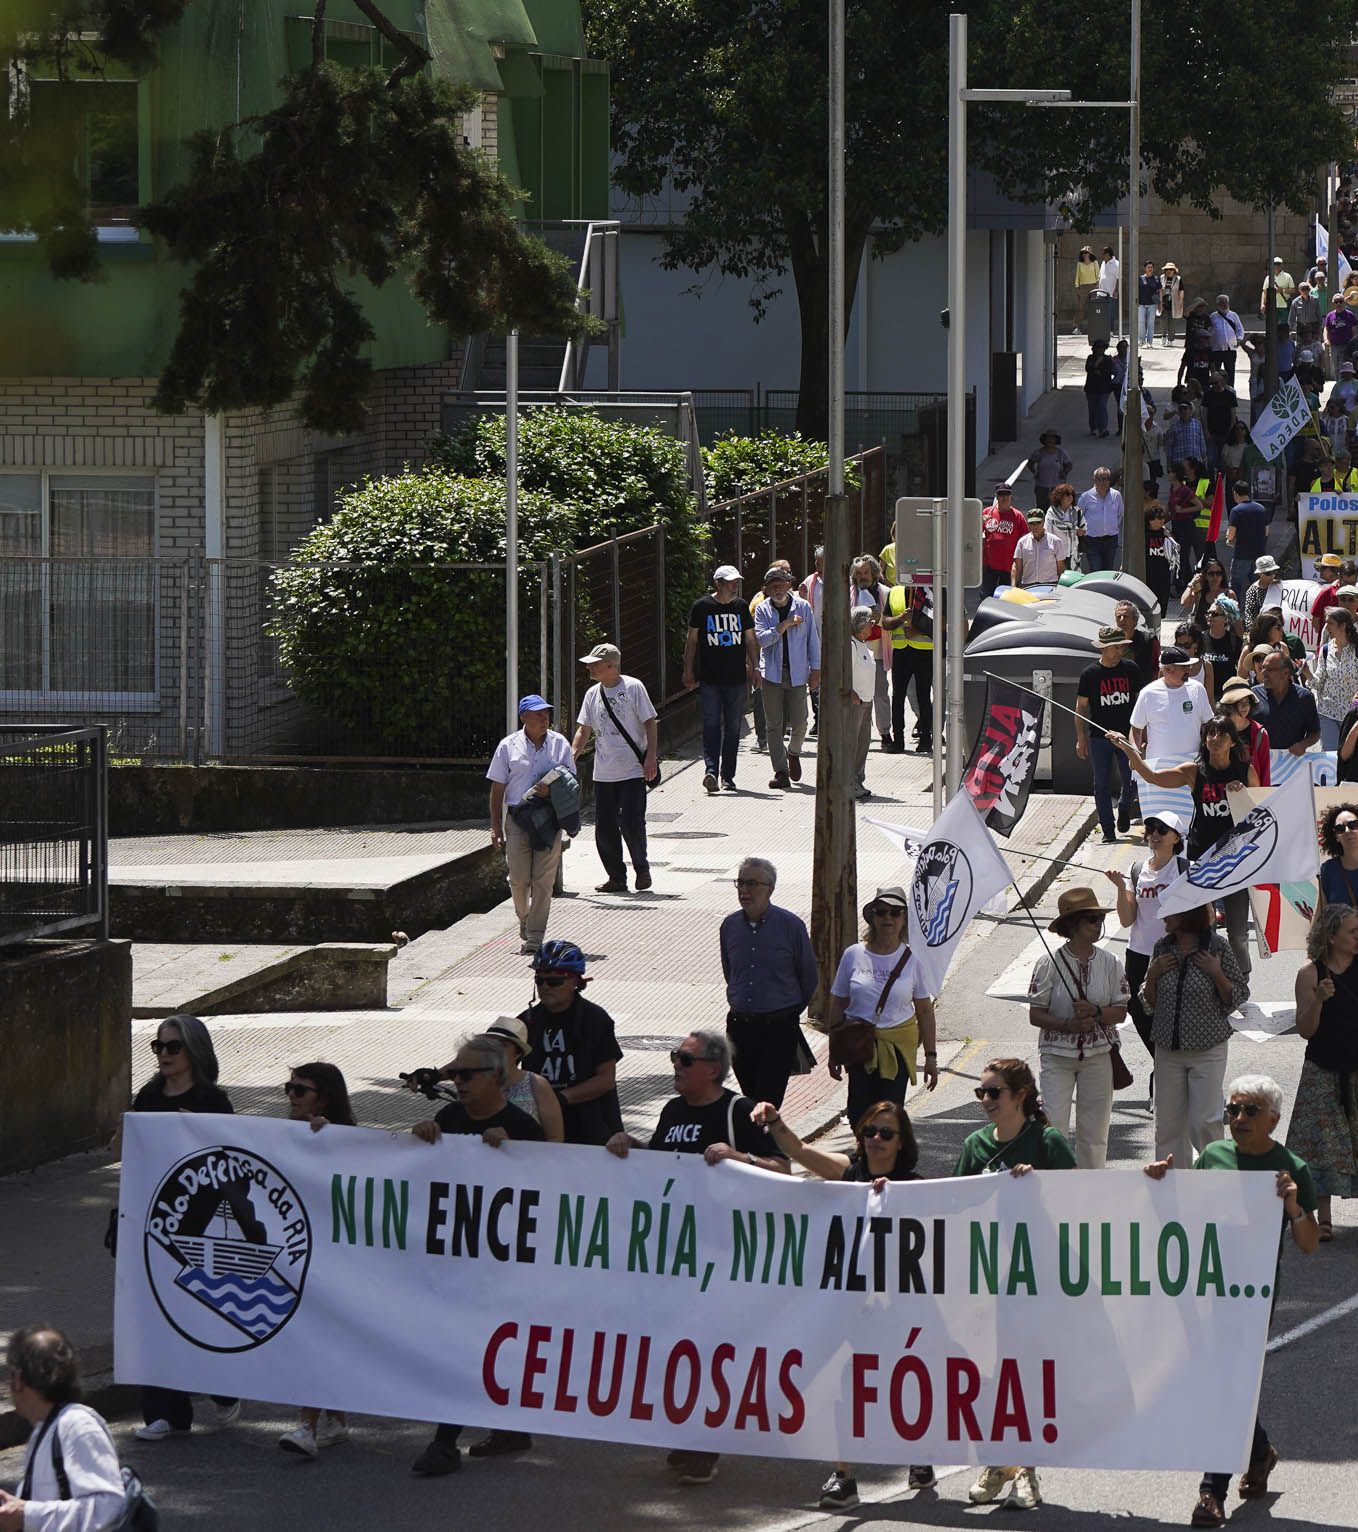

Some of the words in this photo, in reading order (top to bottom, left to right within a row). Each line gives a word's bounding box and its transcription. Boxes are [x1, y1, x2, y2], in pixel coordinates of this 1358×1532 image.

[706, 613, 743, 632] ALTRI
[706, 629, 743, 648] NON
[1100, 677, 1130, 694] ALTRI
[1100, 691, 1130, 706] NON
[1202, 799, 1231, 817] NO
[664, 1123, 703, 1144] ENCE
[150, 1194, 191, 1246] Pola
[177, 1154, 269, 1196] Defensa
[268, 1185, 294, 1221] da
[282, 1218, 307, 1267] RIA
[331, 1173, 409, 1251] NIN
[425, 1181, 541, 1265] ENCE
[554, 1191, 611, 1270] NA
[626, 1178, 716, 1294] RÍA,
[729, 1209, 809, 1289] NIN
[819, 1215, 946, 1296] ALTRI
[969, 1220, 1039, 1298] NA
[1059, 1221, 1273, 1300] ULLOA...
[482, 1321, 806, 1436] CELULOSAS
[852, 1327, 1060, 1446] FÓRA!
